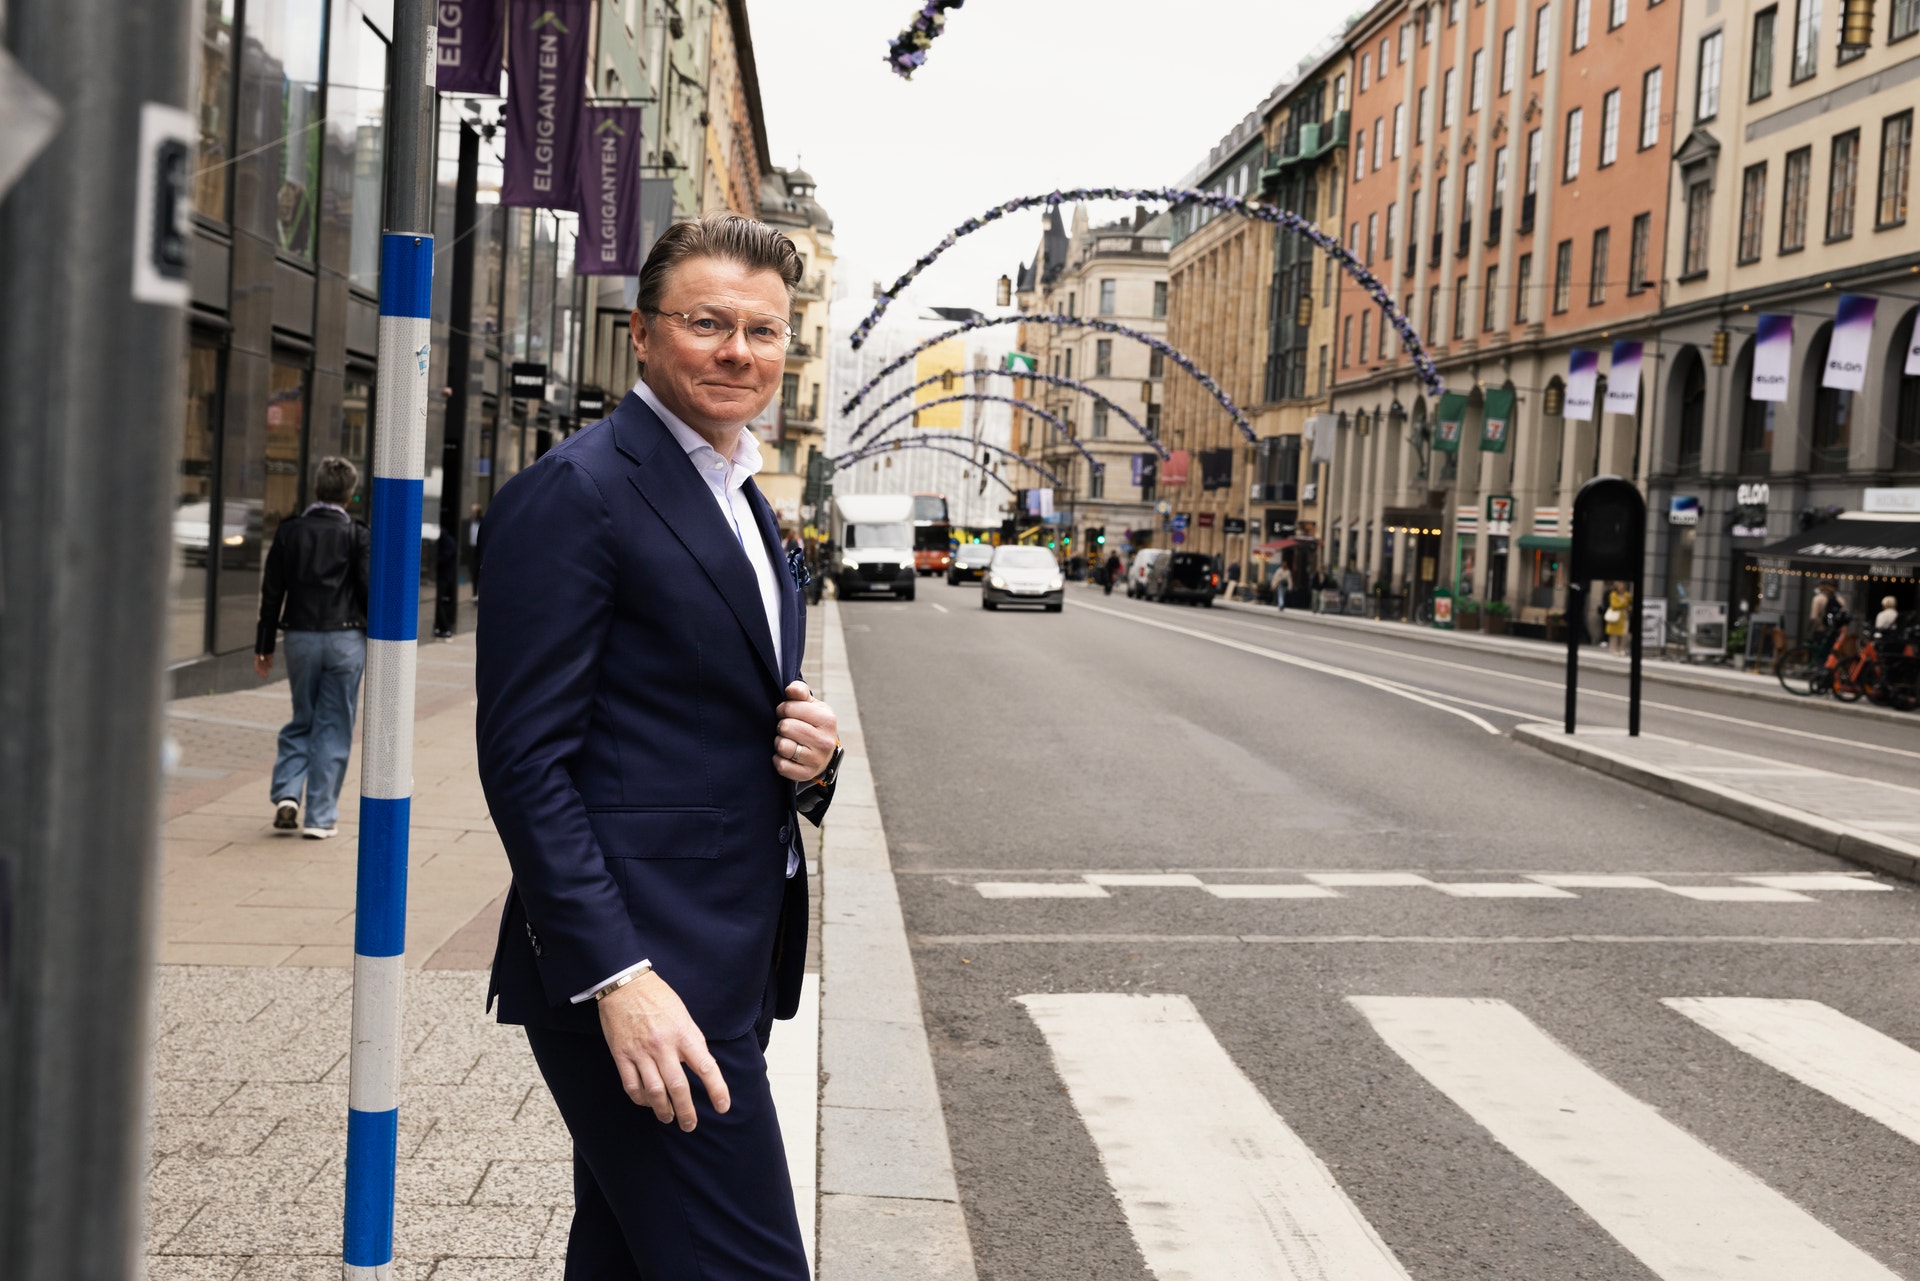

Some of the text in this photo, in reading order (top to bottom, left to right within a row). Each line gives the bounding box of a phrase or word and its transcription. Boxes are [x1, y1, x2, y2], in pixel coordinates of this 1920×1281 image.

[437, 0, 463, 67] ELG
[533, 34, 559, 192] ELGIGANTEN
[600, 137, 617, 263] ELGIGANTEN
